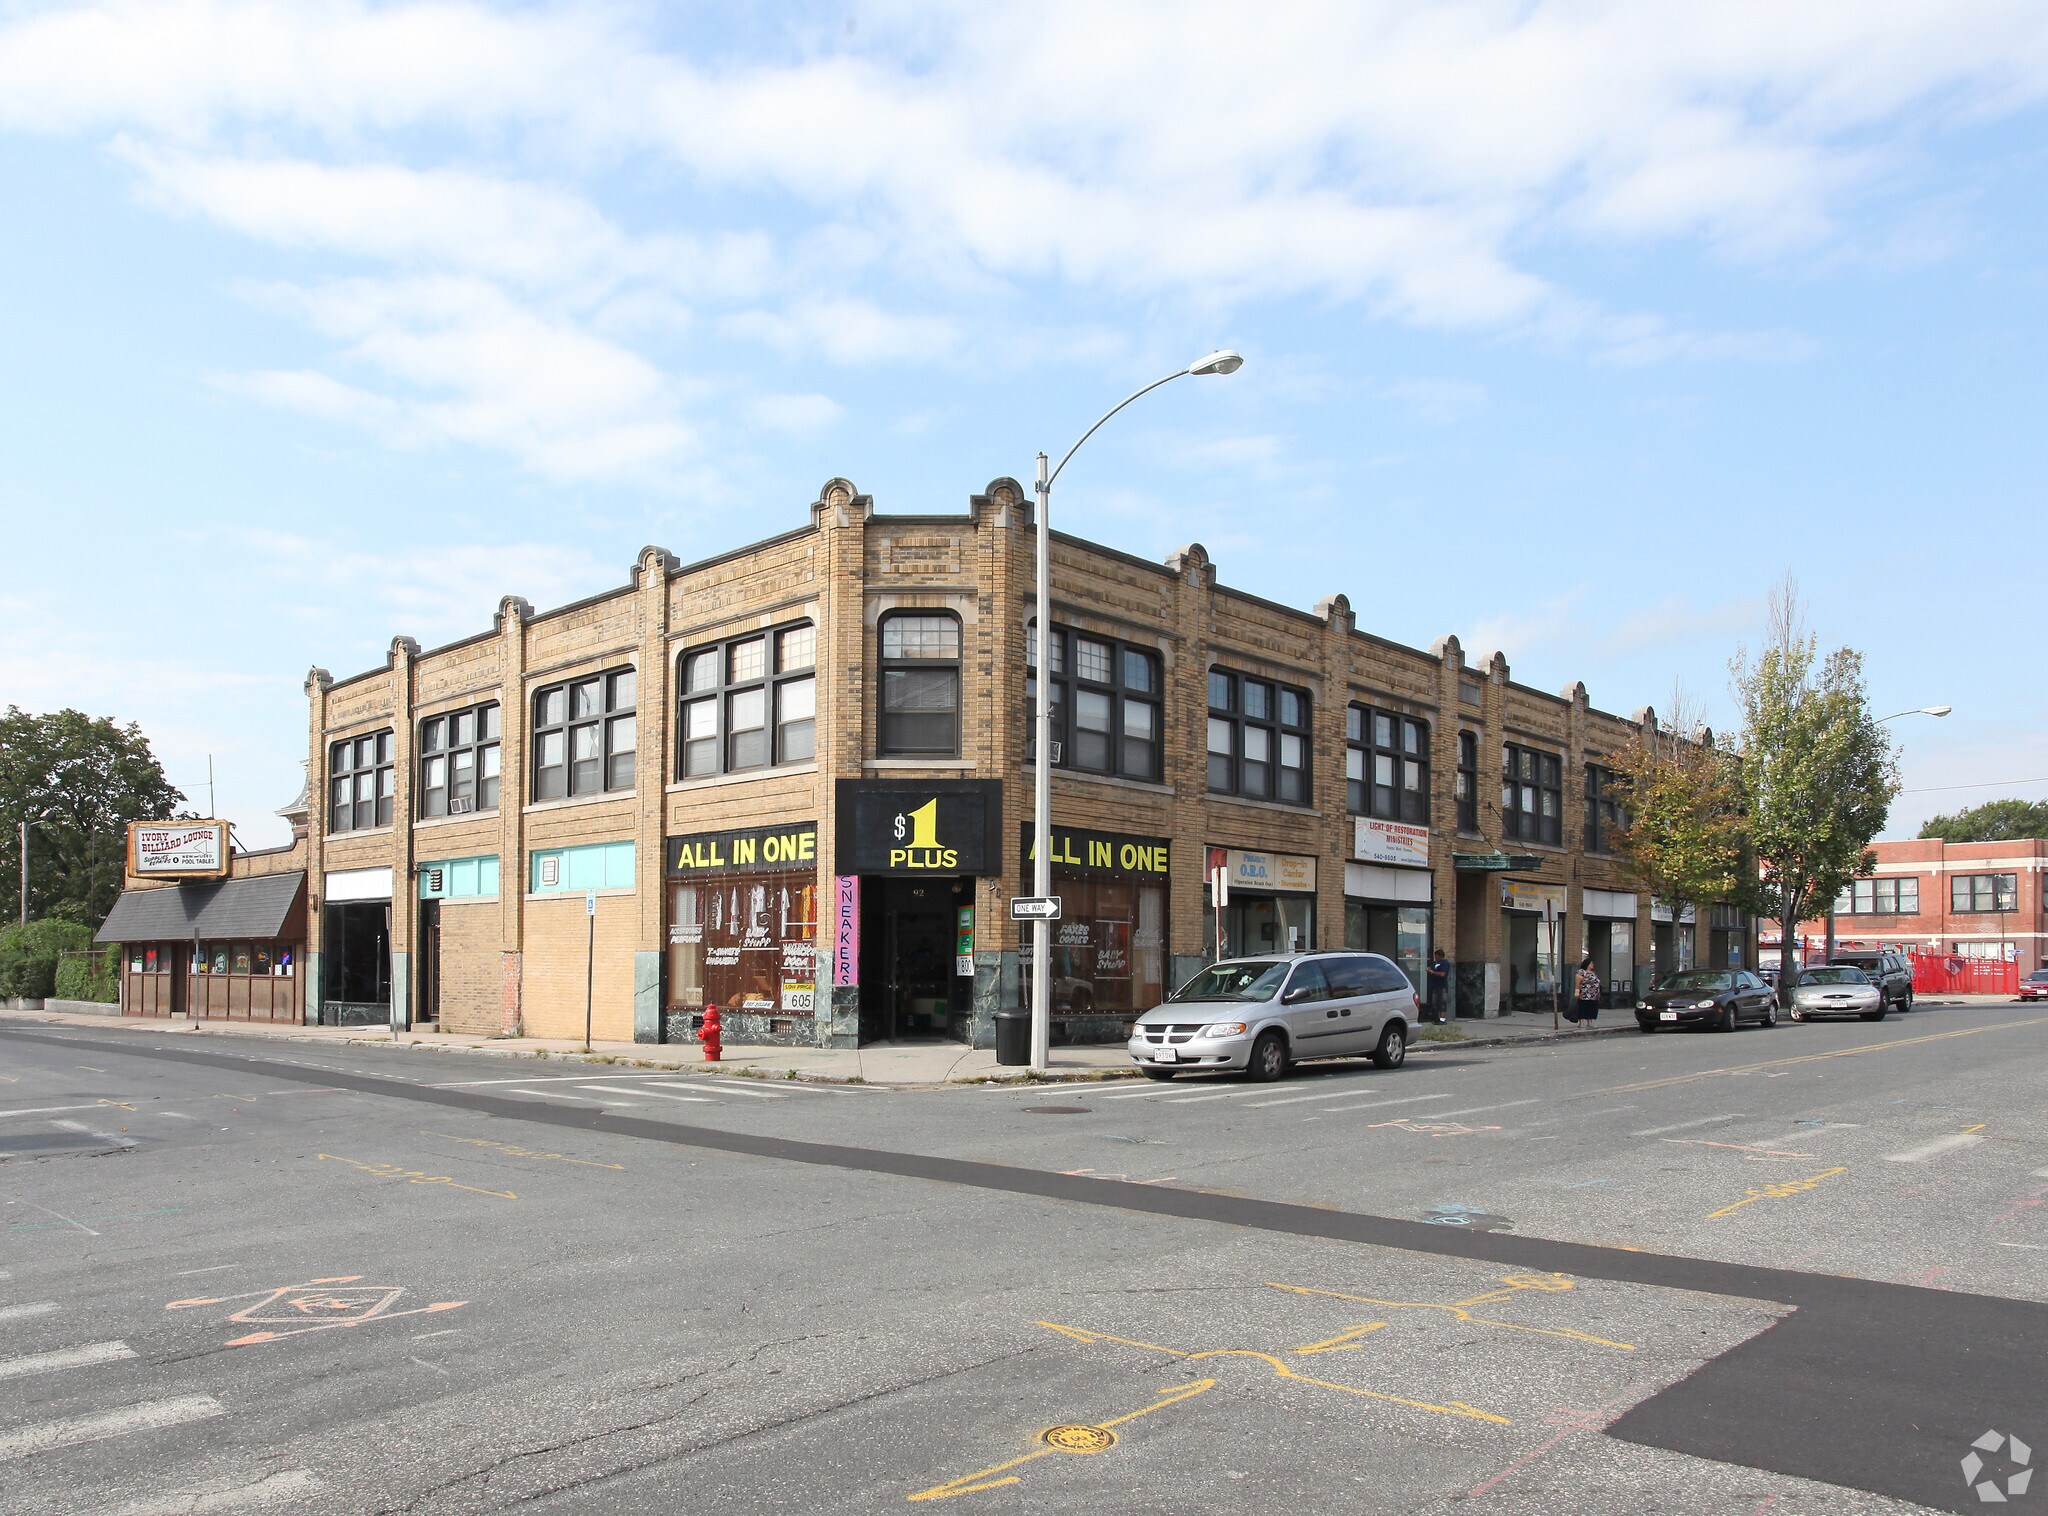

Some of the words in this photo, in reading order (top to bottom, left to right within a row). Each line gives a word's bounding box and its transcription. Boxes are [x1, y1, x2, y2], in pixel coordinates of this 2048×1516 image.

[894, 798, 945, 848] $1
[141, 832, 169, 841] IVORY
[141, 837, 182, 852] BILLIARD
[183, 830, 213, 844] LOUNGE
[1386, 834, 1413, 846] MINISTRIES
[678, 841, 725, 868] ALL
[733, 838, 756, 864] IN
[763, 832, 816, 863] ONE
[890, 849, 958, 868] PLUS
[1088, 840, 1112, 868] IN
[1120, 843, 1168, 873] ONE
[913, 889, 925, 897] 92
[1016, 904, 1030, 913] ONE
[1031, 903, 1046, 913] WAY
[840, 874, 853, 985] SNEAKERS
